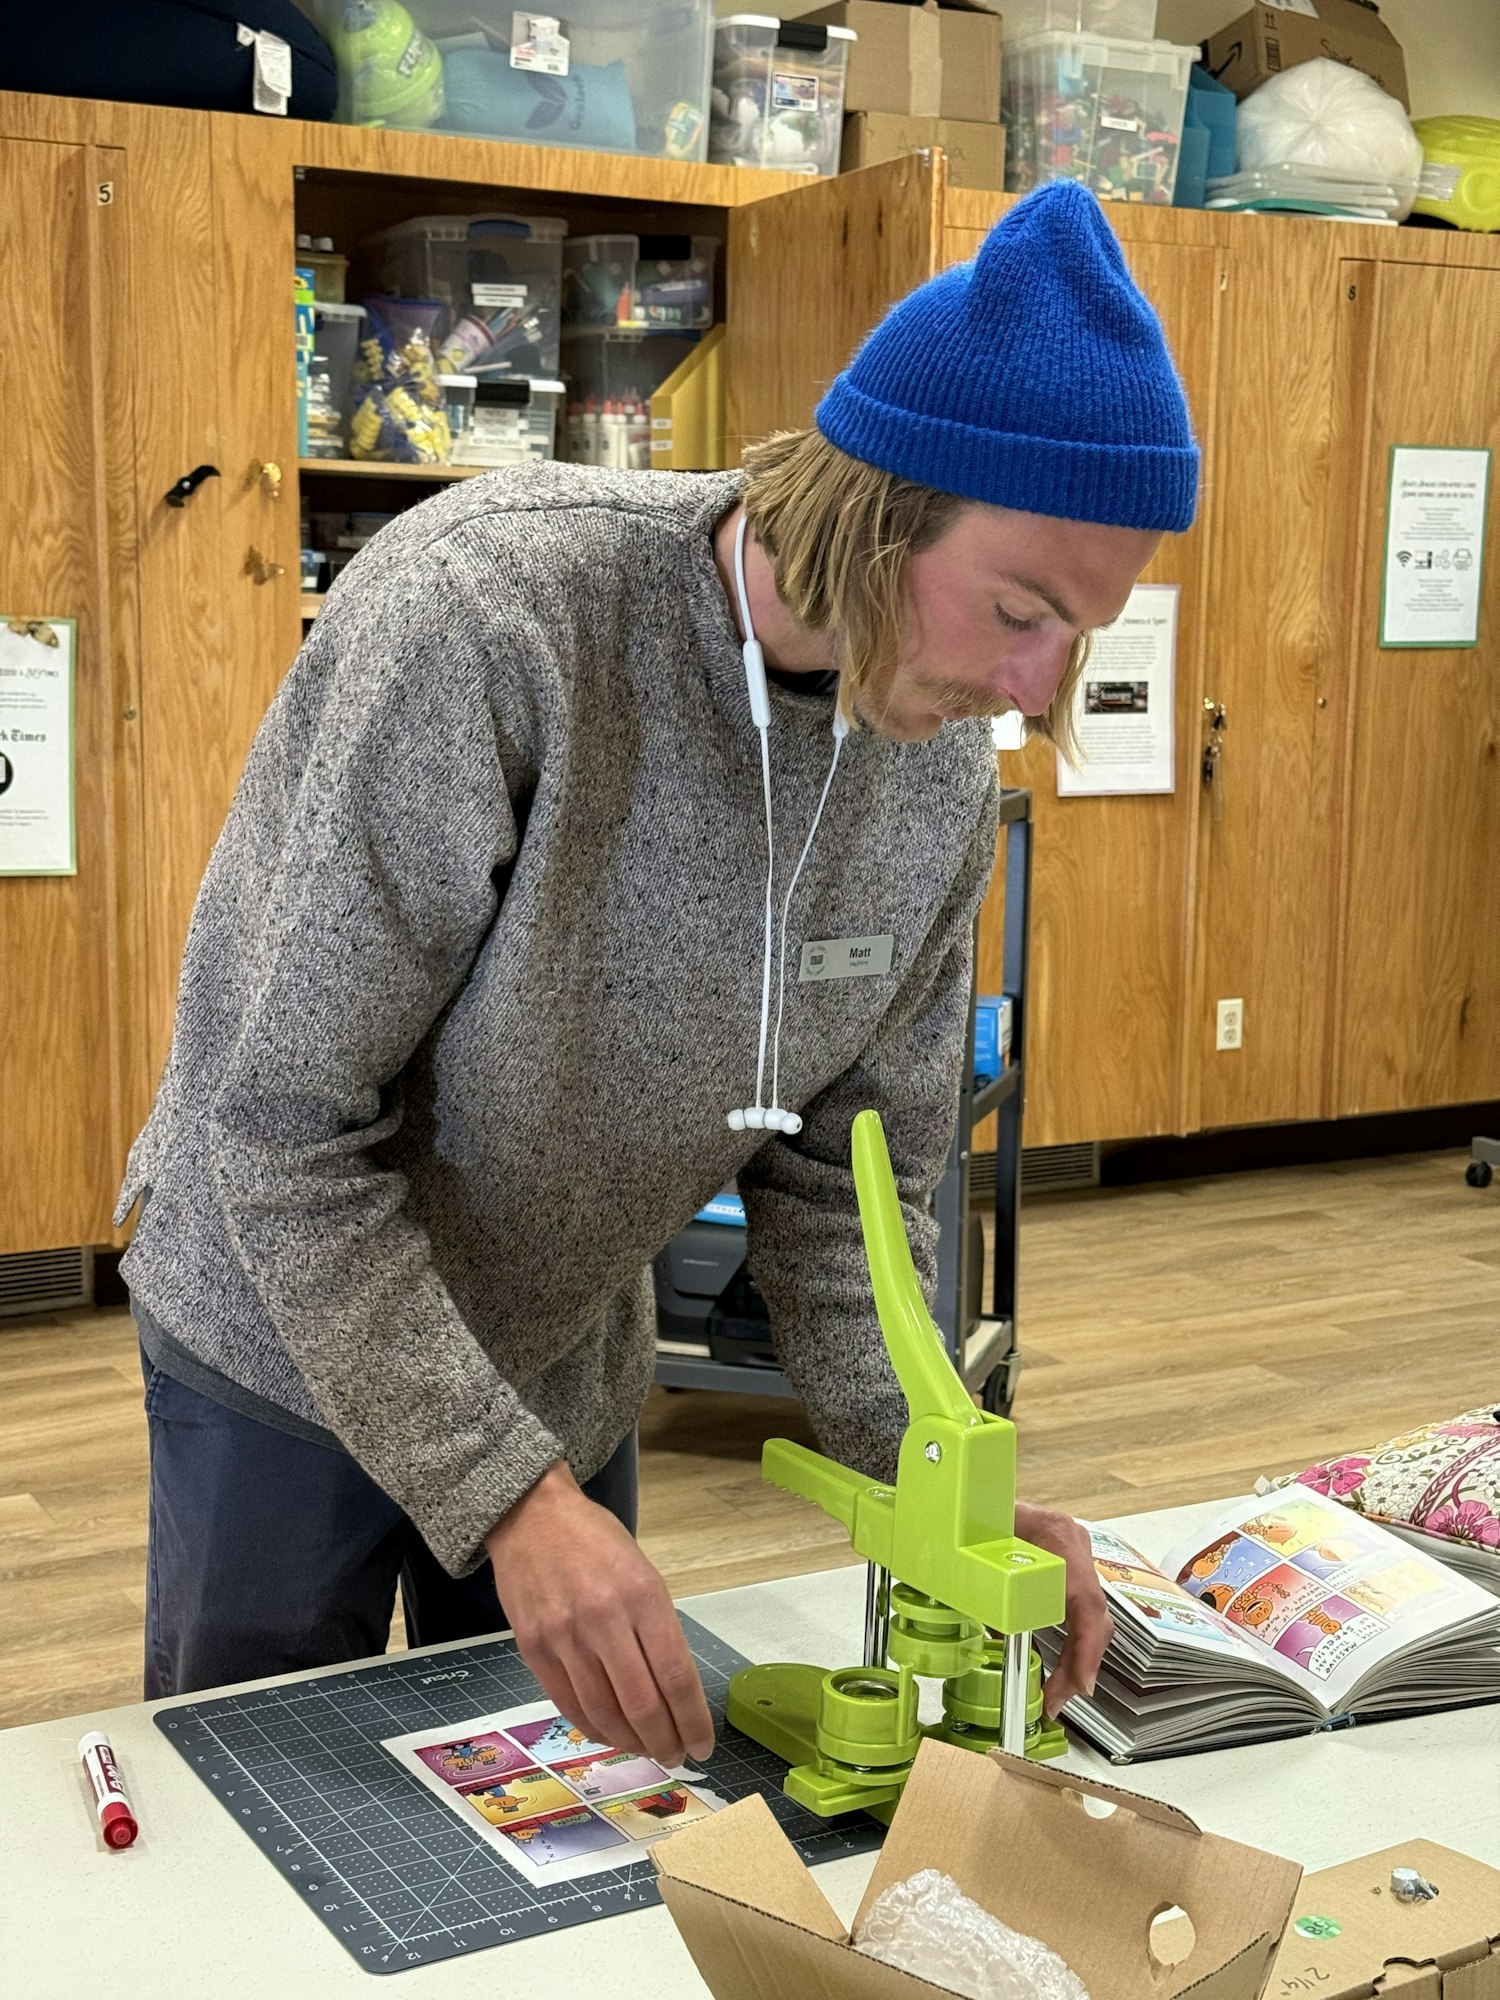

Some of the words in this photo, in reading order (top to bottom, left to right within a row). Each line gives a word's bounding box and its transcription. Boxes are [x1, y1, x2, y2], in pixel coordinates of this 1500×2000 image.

[99, 184, 111, 203] 5
[1347, 284, 1357, 301] 8
[11, 728, 47, 742] Times
[849, 947, 871, 958] Matt
[420, 1669, 474, 1685] Cricut
[184, 1706, 199, 1714] 12
[276, 1845, 285, 1853] 7
[804, 1851, 815, 1859] 3
[308, 1883, 319, 1891] 9
[323, 1903, 340, 1912] 10
[591, 1905, 603, 1913] 8
[547, 1916, 559, 1924] 9
[343, 1924, 357, 1933] 11
[500, 1927, 517, 1936] 10
[453, 1939, 468, 1948] 11
[361, 1945, 377, 1954] 12
[406, 1951, 422, 1961] 12
